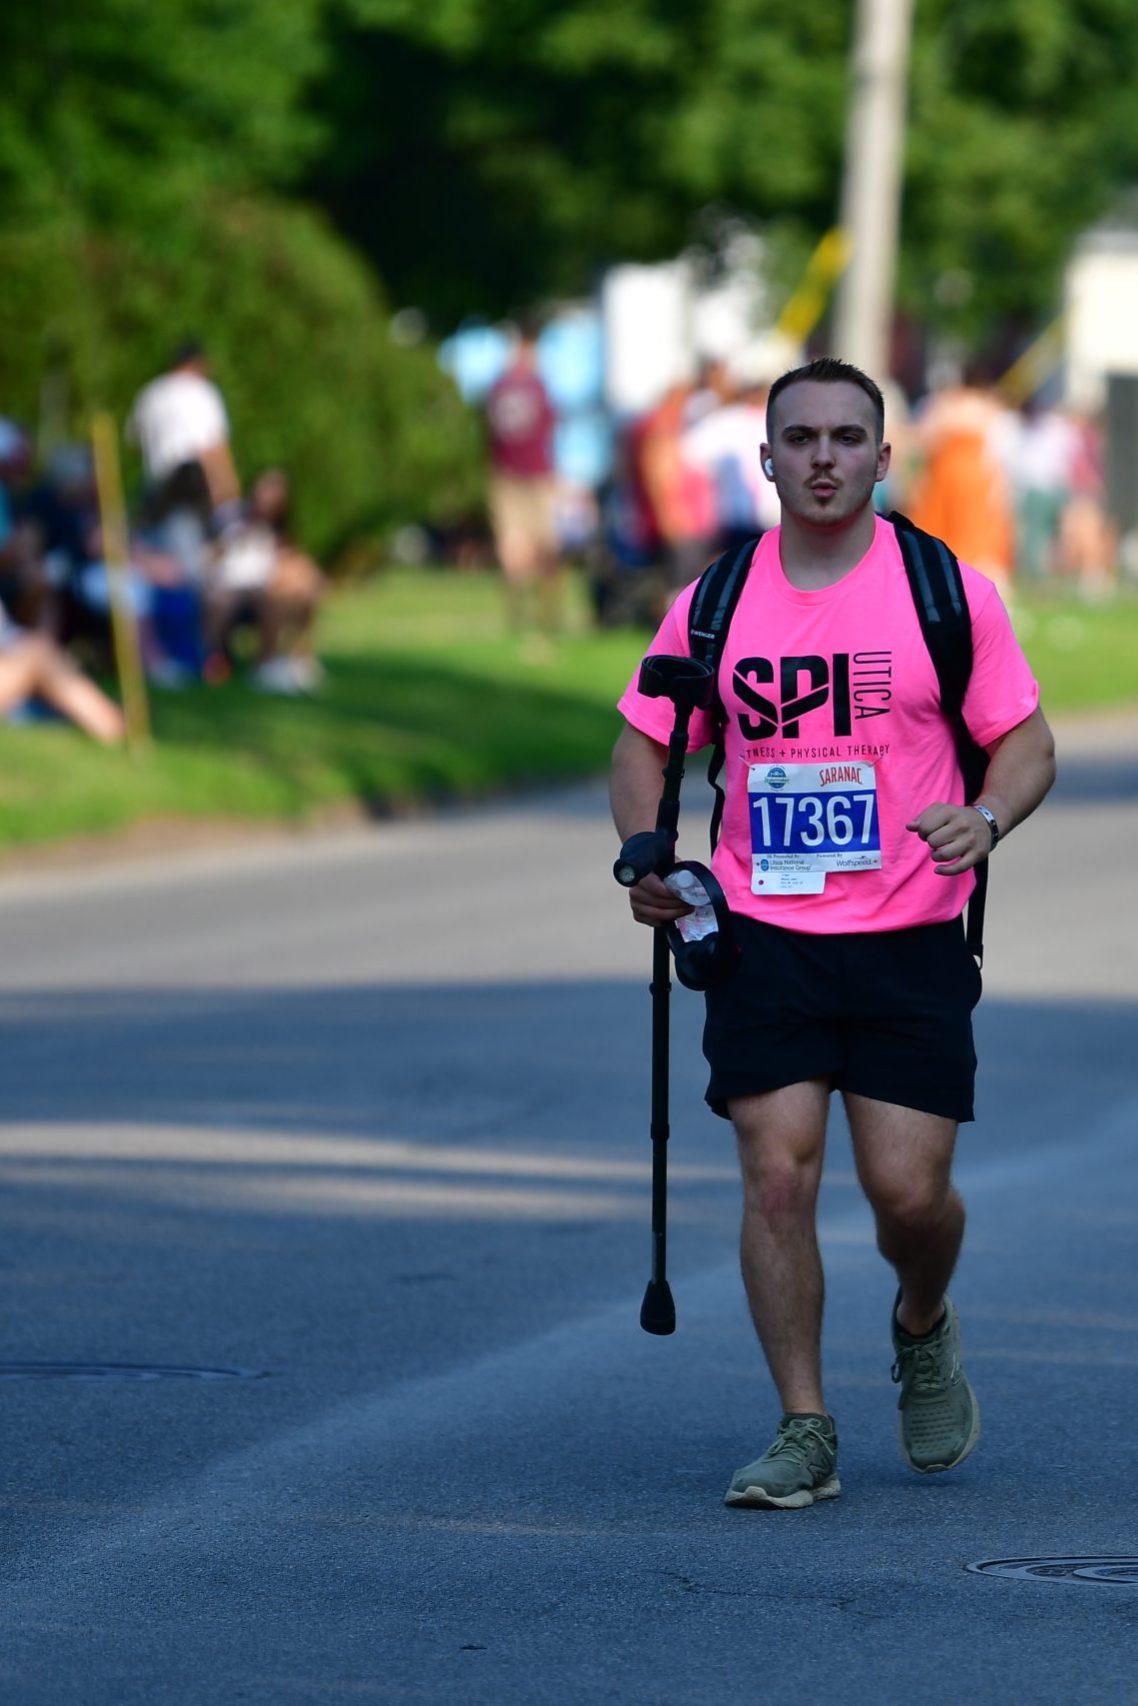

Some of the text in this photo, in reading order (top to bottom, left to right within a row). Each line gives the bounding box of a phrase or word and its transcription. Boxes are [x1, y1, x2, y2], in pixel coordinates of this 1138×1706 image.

[732, 653, 852, 741] SPI
[853, 651, 892, 720] UTICA
[745, 747, 775, 759] TNESS
[791, 746, 841, 759] PHYSICAL
[848, 744, 890, 757] THERAPY
[819, 766, 863, 787] SARANAC
[753, 794, 875, 847] 17367
